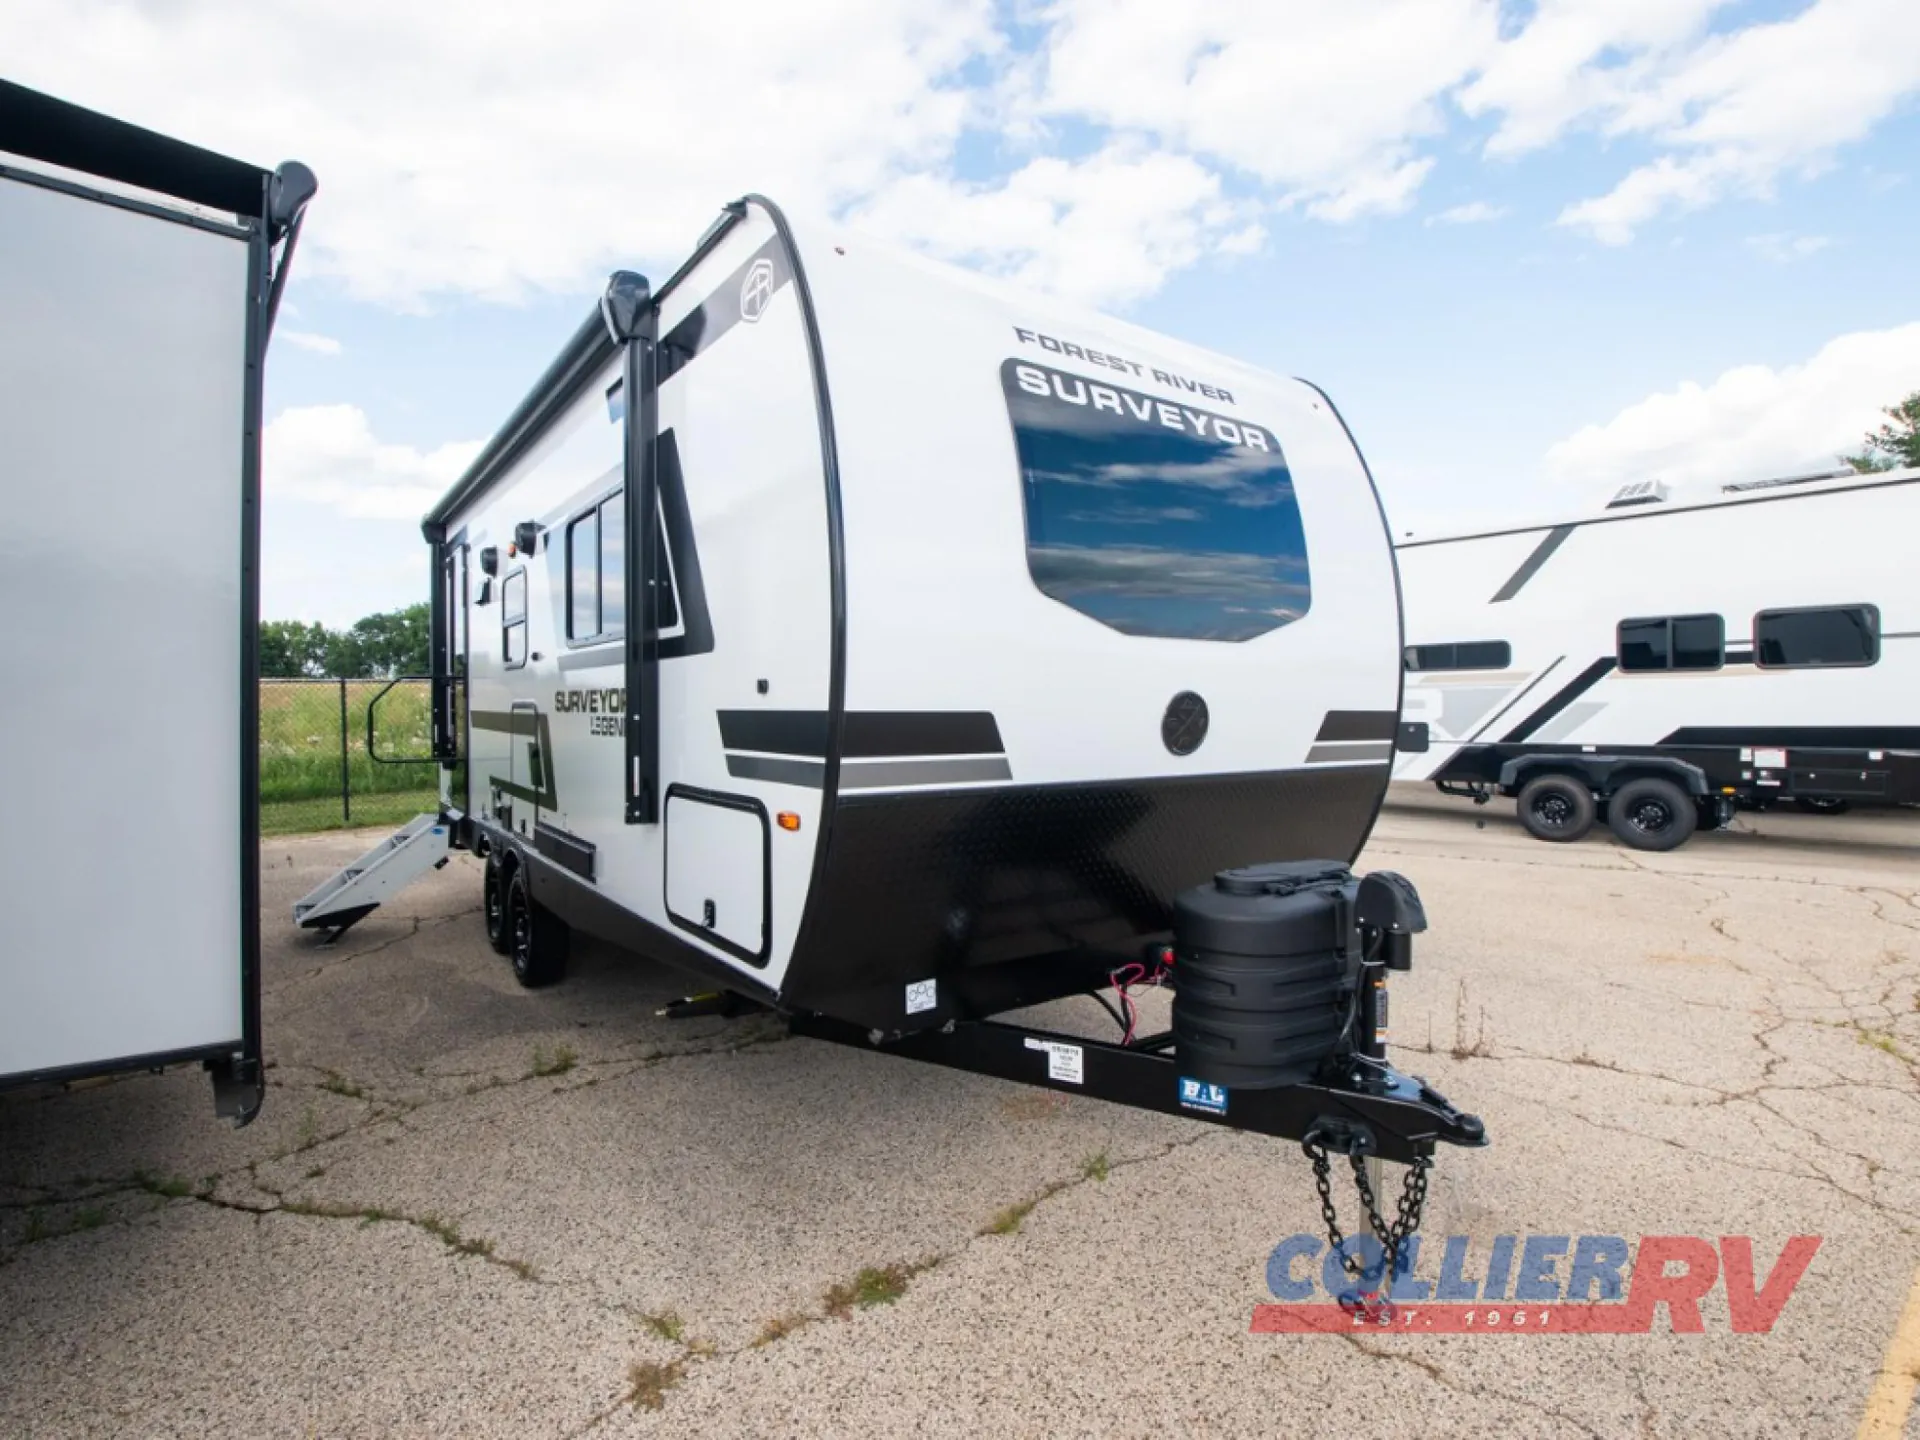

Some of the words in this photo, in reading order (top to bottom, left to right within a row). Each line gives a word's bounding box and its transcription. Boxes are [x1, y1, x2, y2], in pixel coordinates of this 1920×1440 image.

[1013, 326, 1144, 377] FOREST
[1151, 367, 1235, 404] RIVER
[1015, 365, 1270, 452] SURVEYOR
[590, 716, 627, 737] LEGEN
